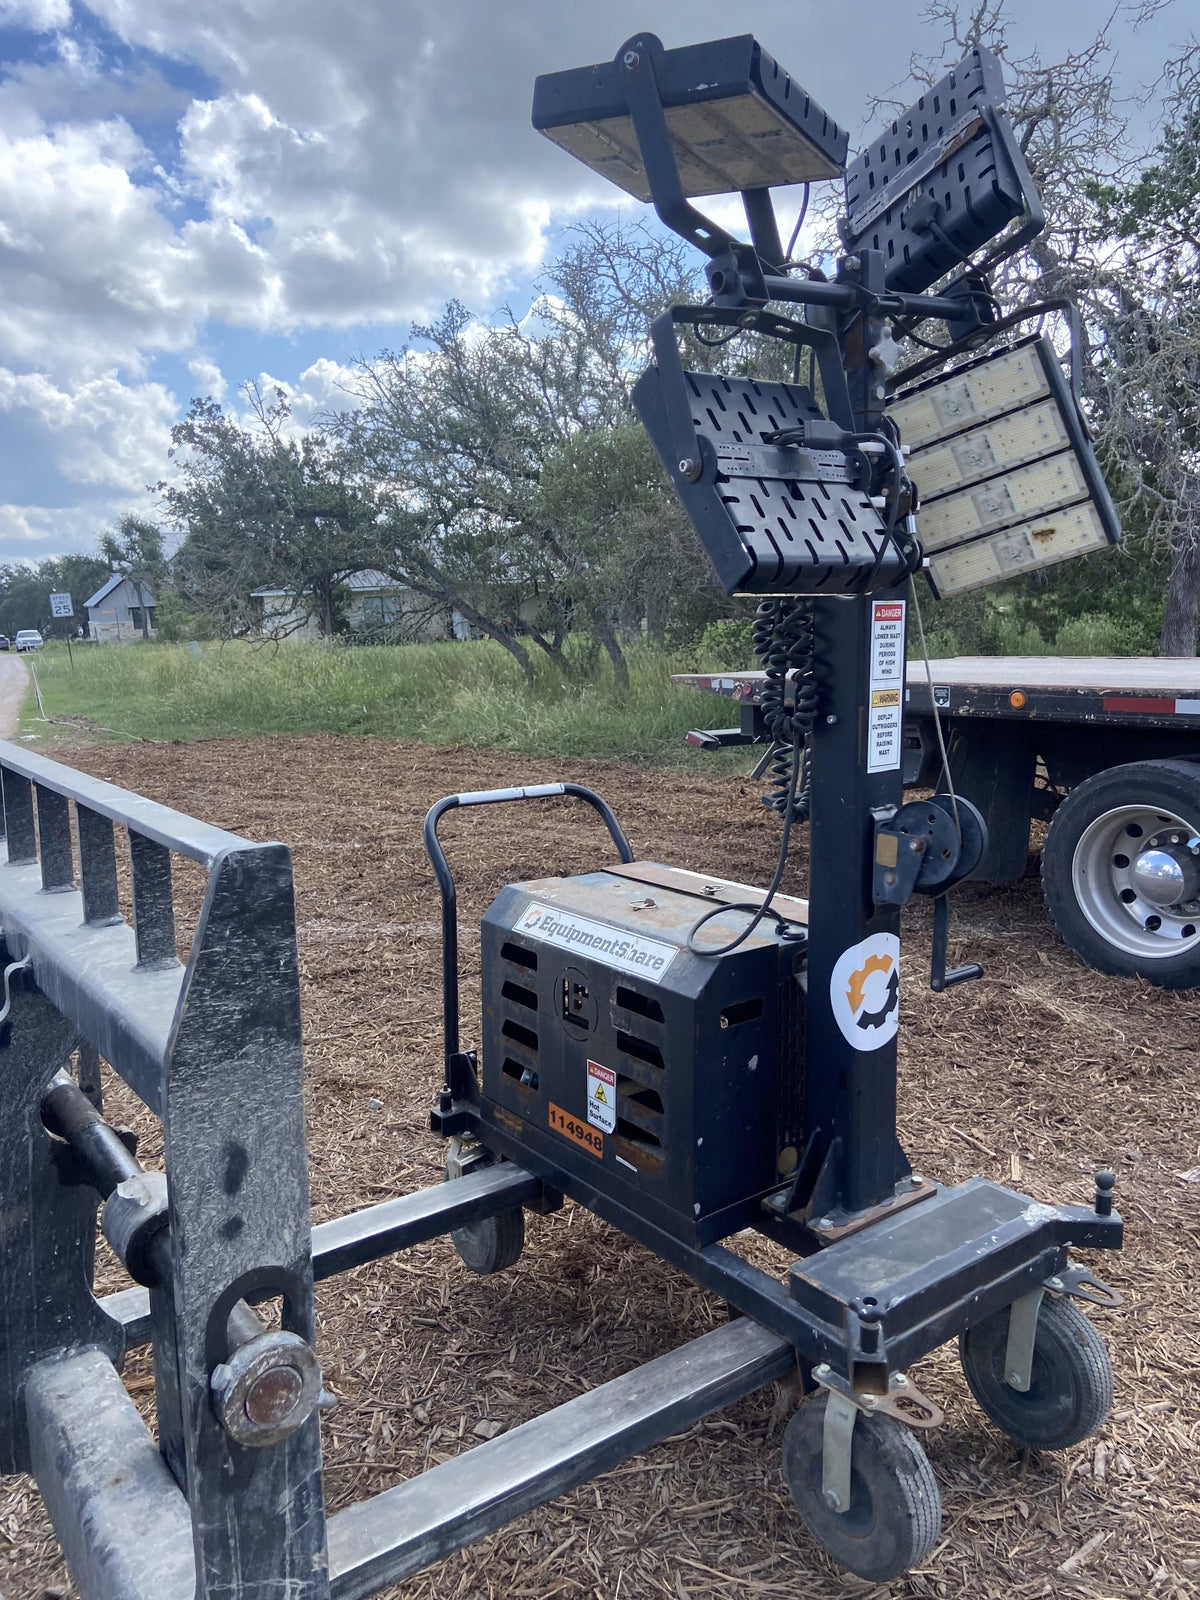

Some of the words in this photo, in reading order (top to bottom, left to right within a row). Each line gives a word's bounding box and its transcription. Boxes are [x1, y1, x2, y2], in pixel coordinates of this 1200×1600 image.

[54, 605, 70, 614] 25
[881, 608, 901, 617] DANGER
[879, 693, 898, 703] WARNING
[872, 722, 898, 730] OUTRIGGERS
[538, 915, 665, 971] EquipmentShare
[594, 1067, 614, 1083] DANGER
[589, 1100, 600, 1112] Hot
[550, 1110, 603, 1152] 114948
